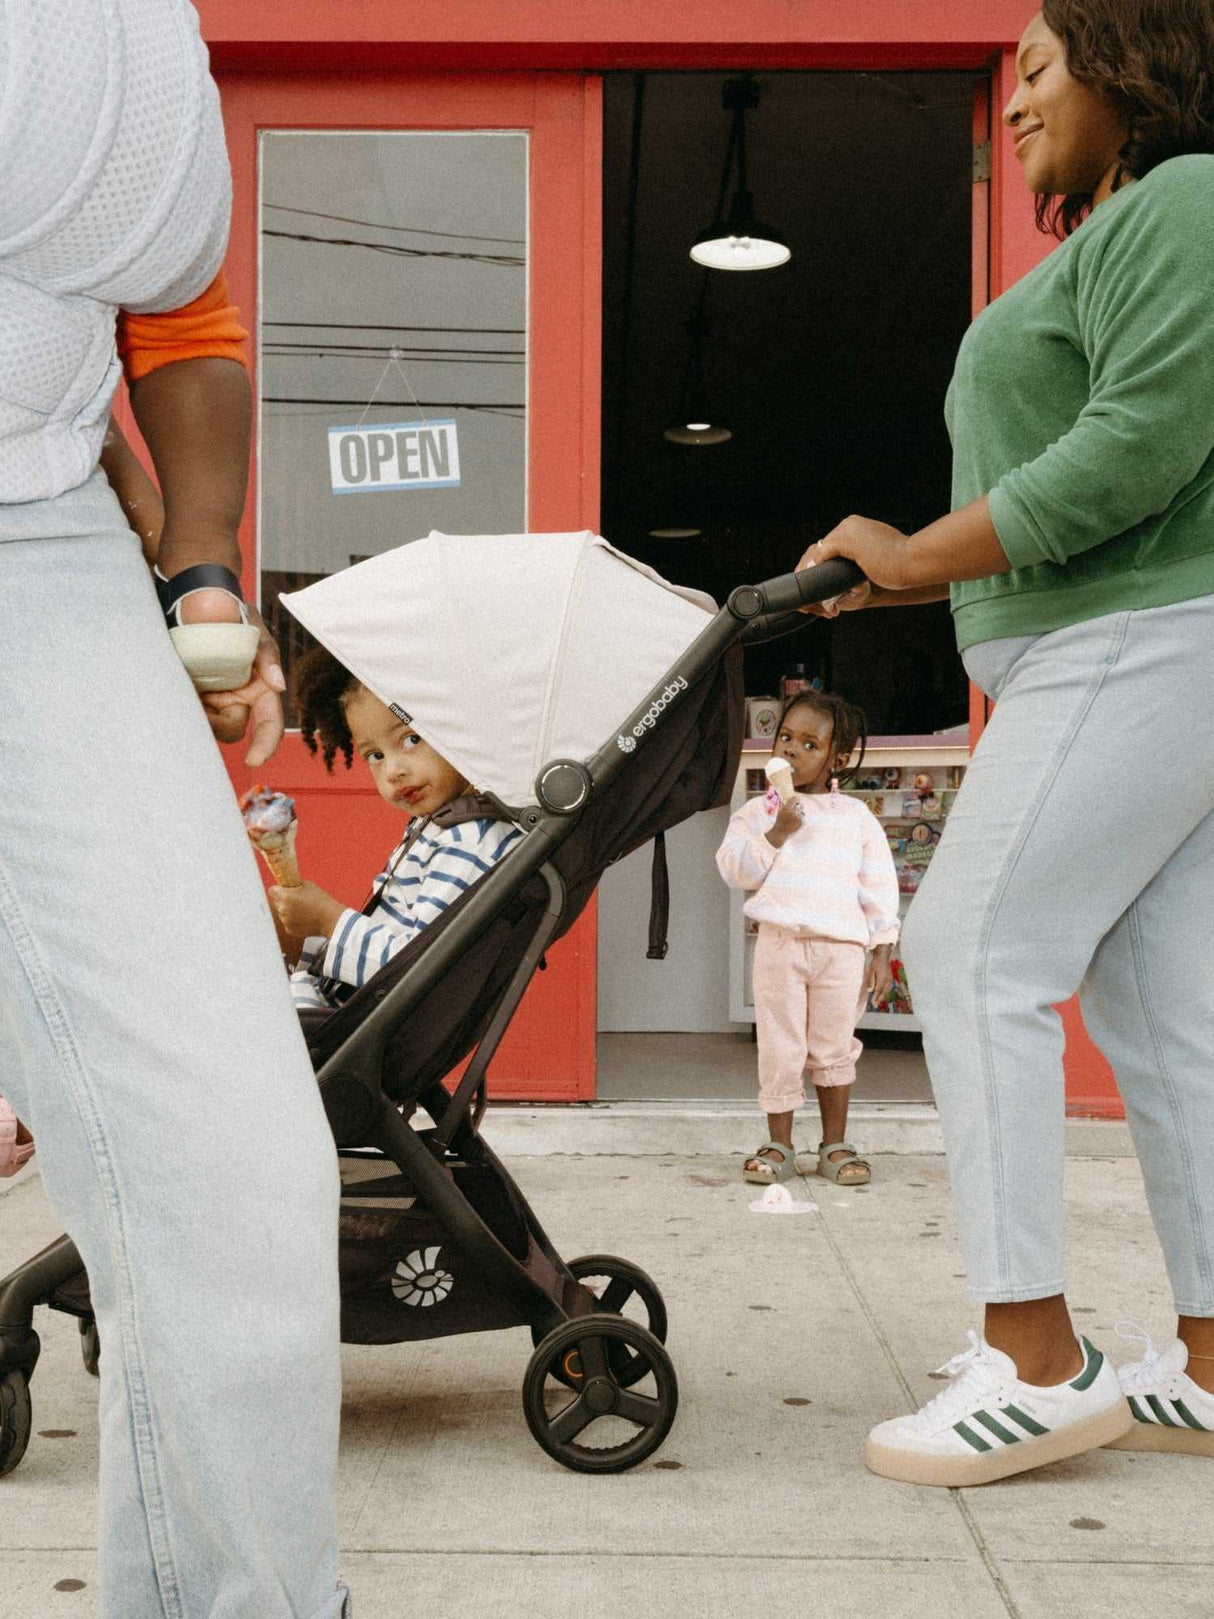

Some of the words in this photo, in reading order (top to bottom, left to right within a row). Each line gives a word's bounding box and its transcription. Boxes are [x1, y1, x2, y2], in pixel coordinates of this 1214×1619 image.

[339, 429, 450, 484] OPEN
[390, 704, 410, 724] metro
[633, 676, 688, 737] ergobaby
